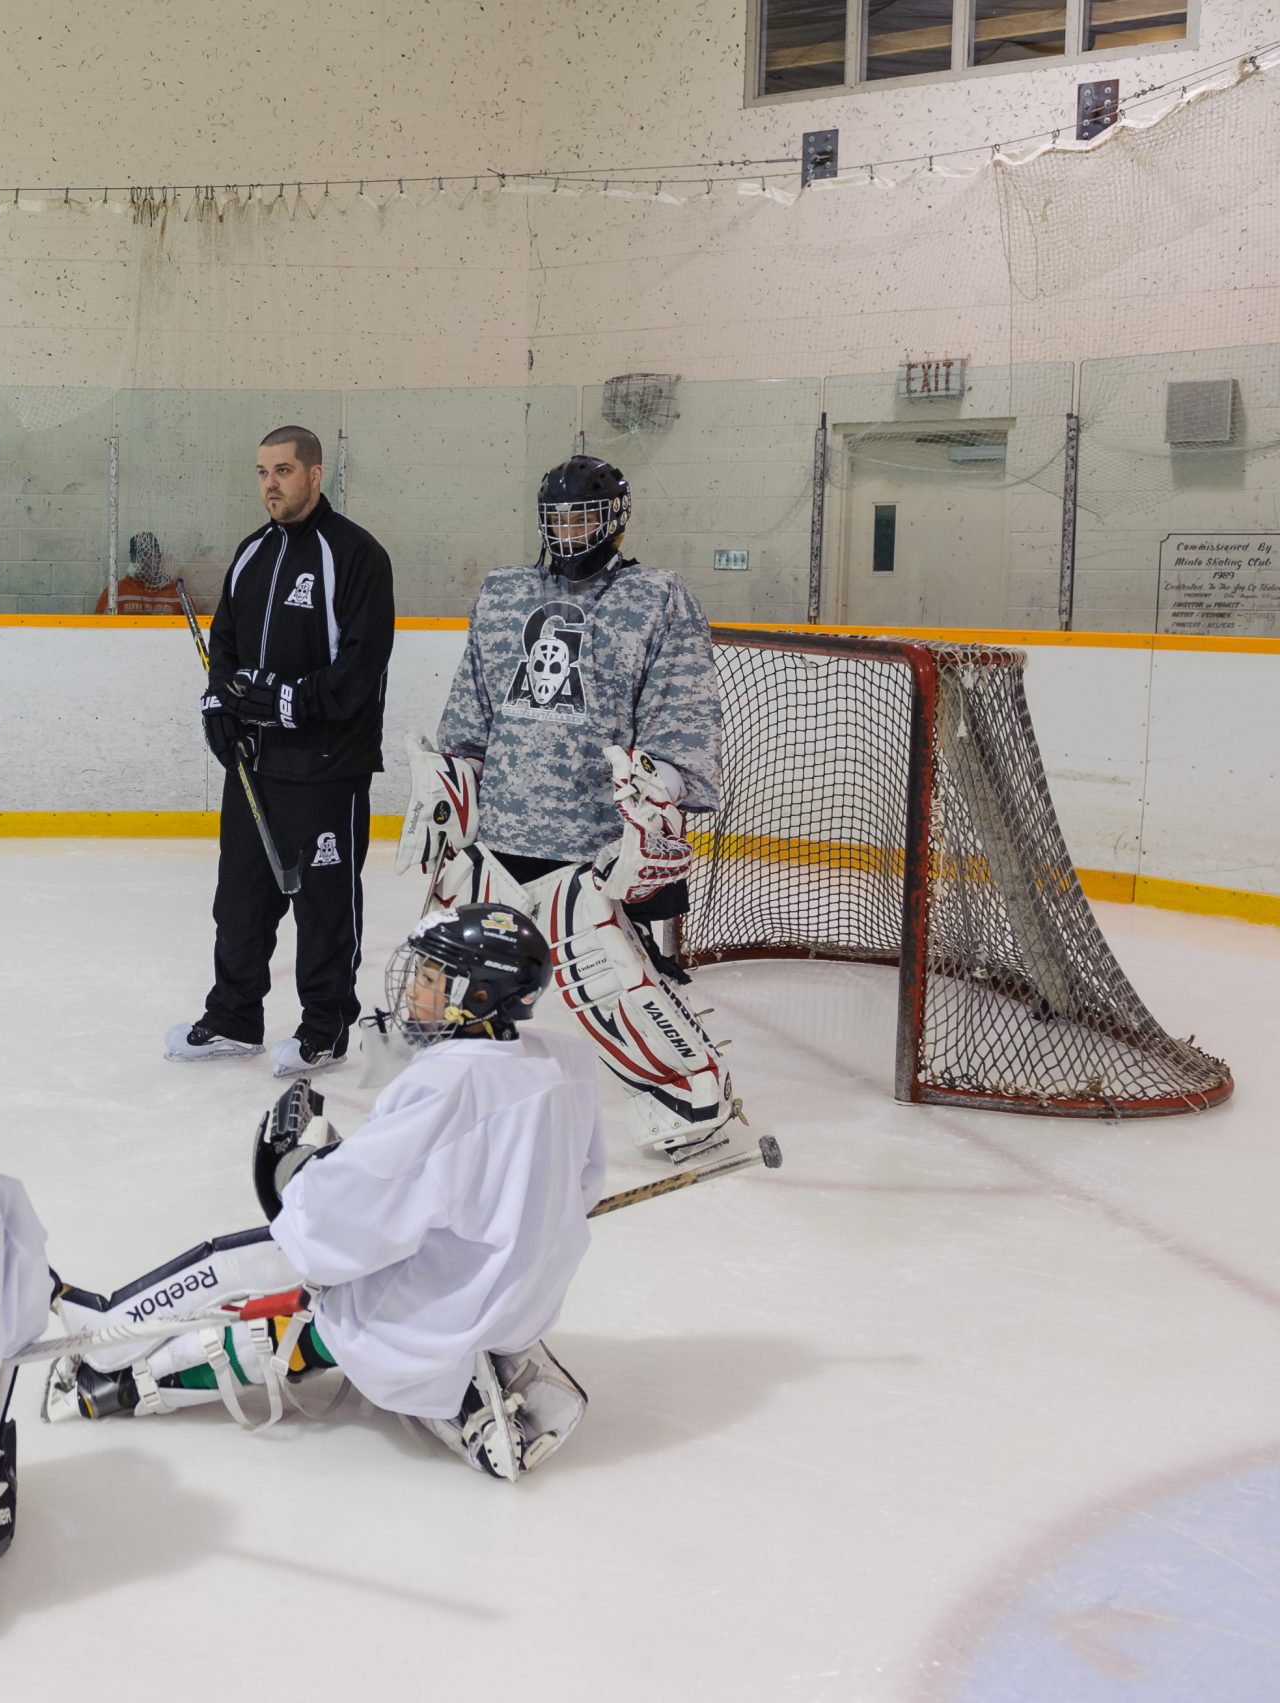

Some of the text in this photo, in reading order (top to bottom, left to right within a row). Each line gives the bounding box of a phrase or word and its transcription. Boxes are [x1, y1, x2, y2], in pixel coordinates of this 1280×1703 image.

[906, 361, 955, 388] EXIT
[1176, 542, 1273, 554] Commissioned By
[1205, 557, 1244, 570] Skating
[1212, 571, 1236, 579] 1989
[642, 1000, 697, 1060] VAUGHN
[125, 1264, 219, 1324] Reebok
